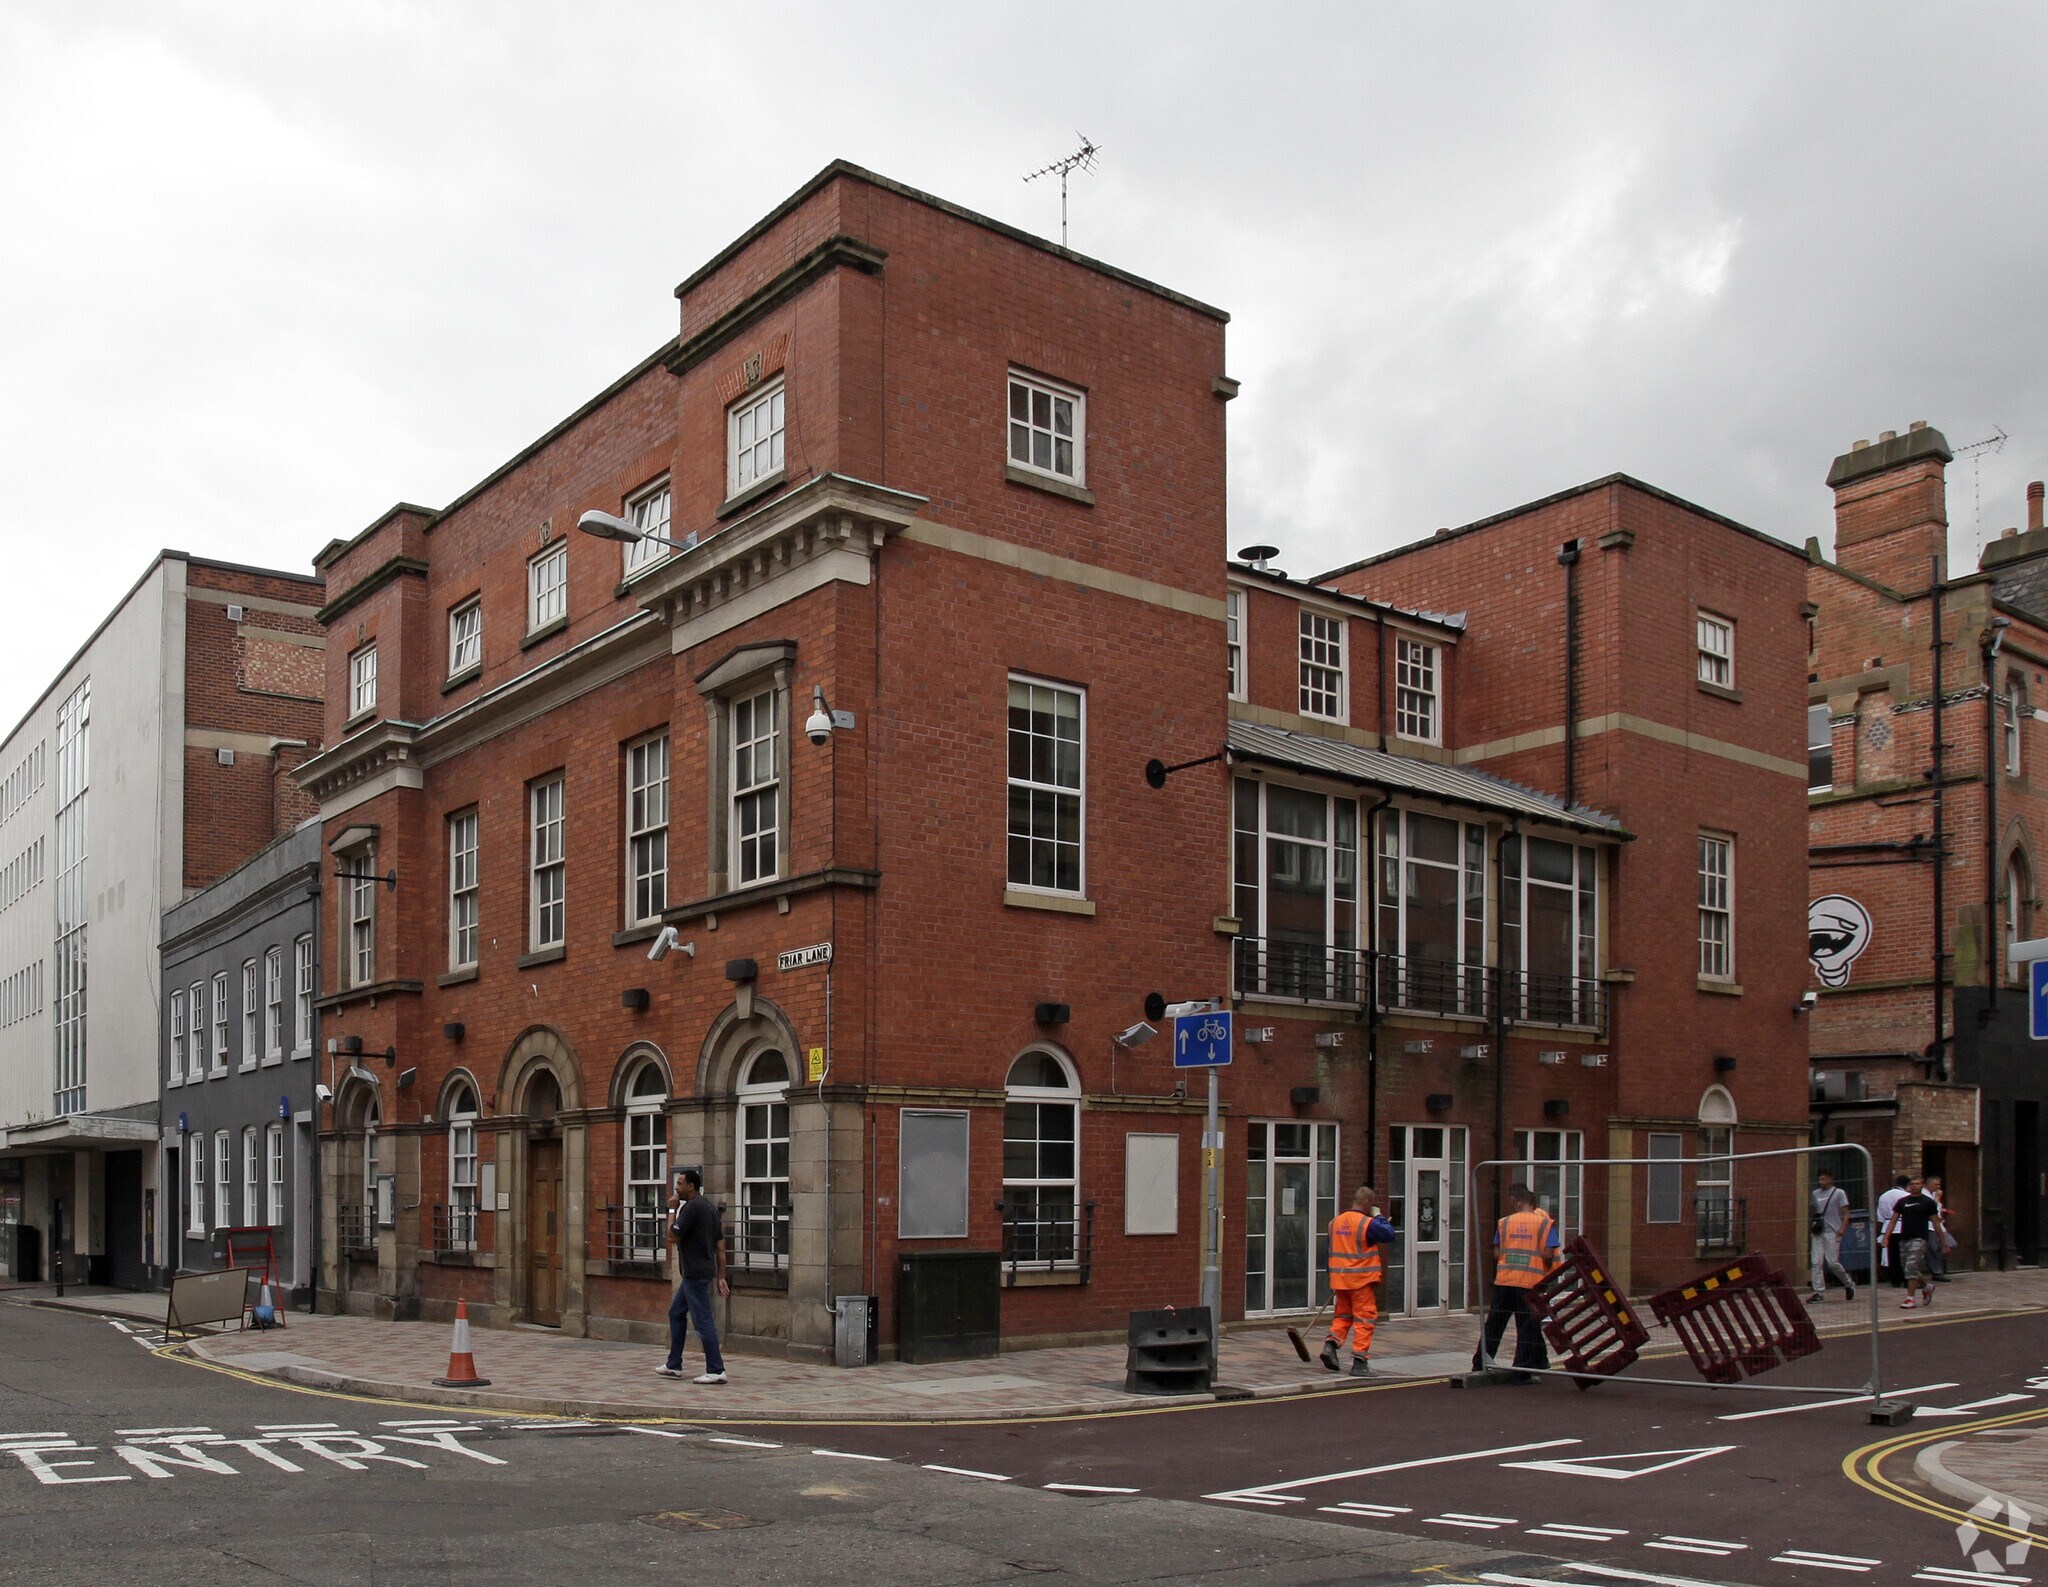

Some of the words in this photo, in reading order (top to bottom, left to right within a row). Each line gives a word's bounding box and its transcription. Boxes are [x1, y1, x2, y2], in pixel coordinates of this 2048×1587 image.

[780, 953, 803, 969] FRIAR
[805, 947, 828, 962] LANE
[6, 1433, 509, 1485] ENTRY
